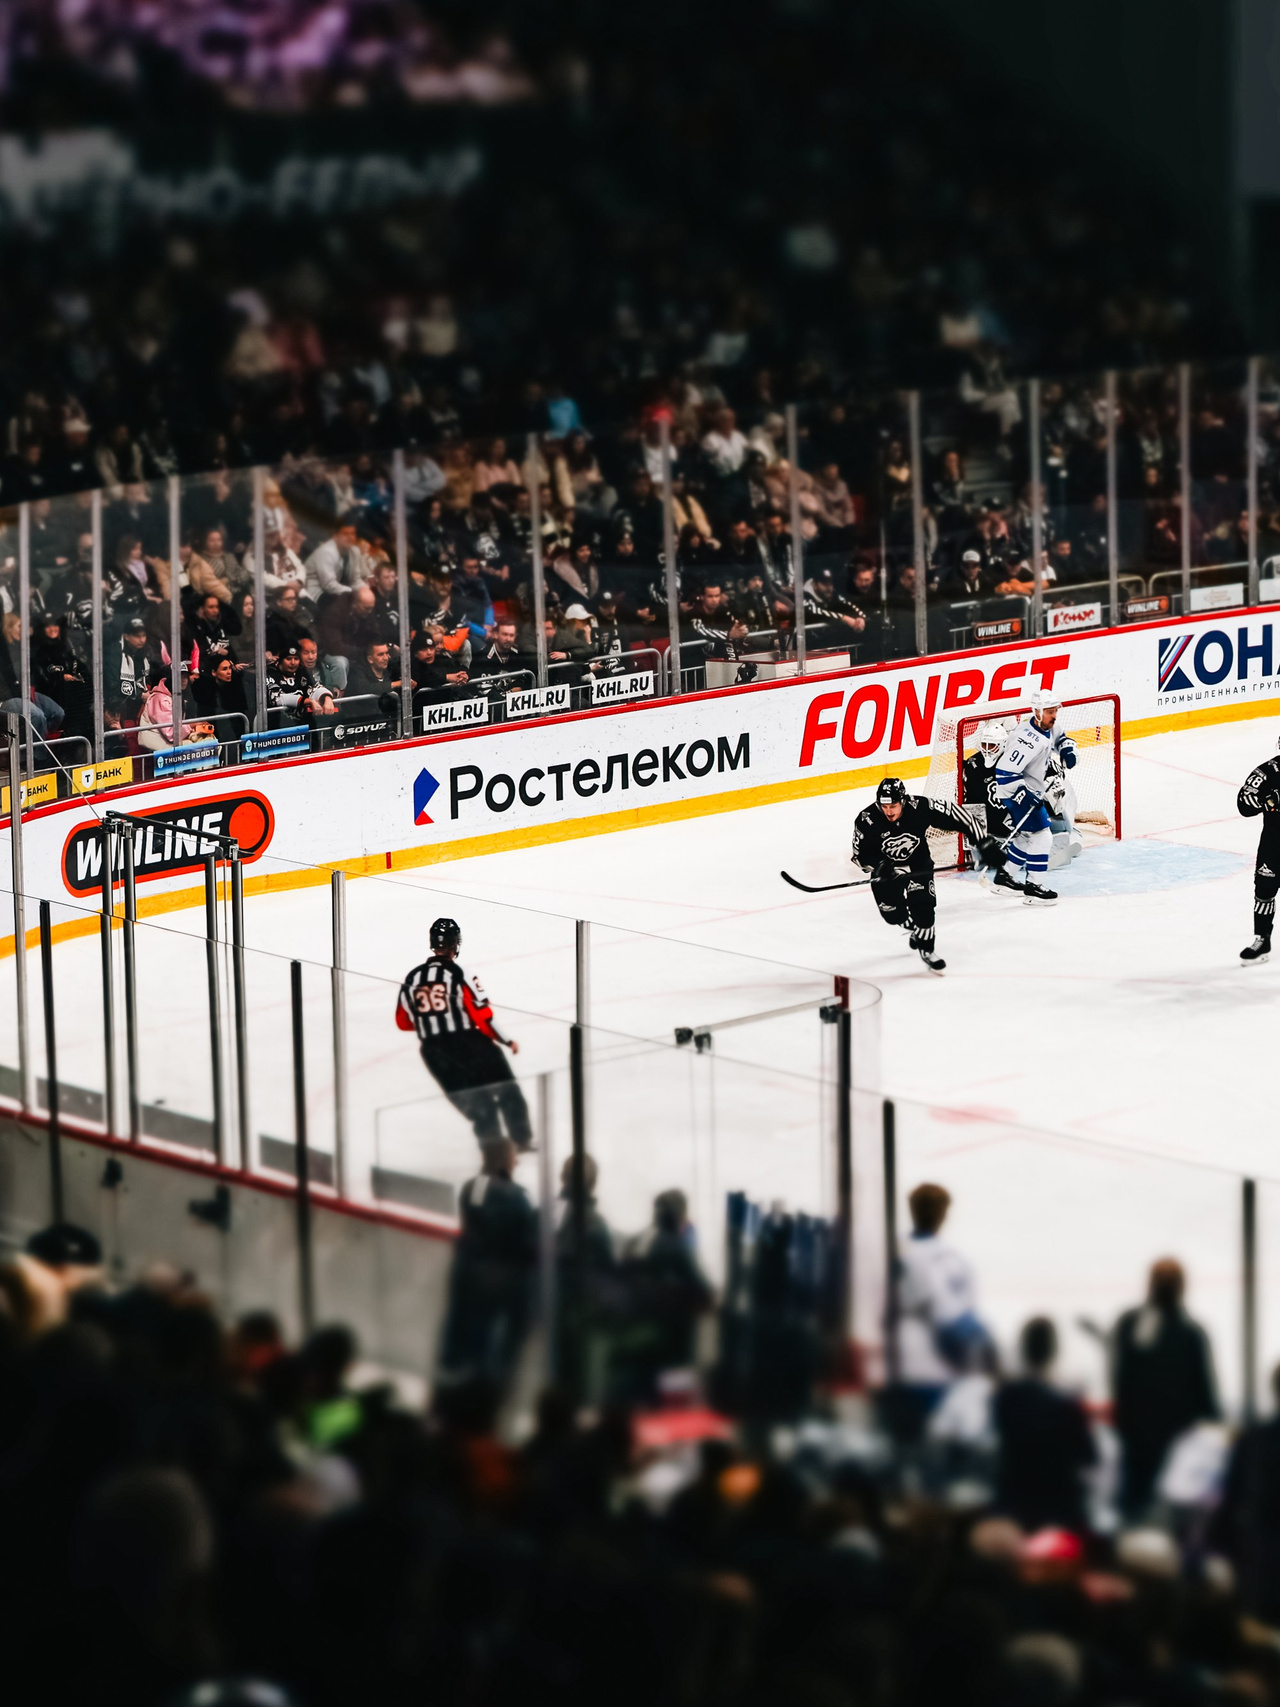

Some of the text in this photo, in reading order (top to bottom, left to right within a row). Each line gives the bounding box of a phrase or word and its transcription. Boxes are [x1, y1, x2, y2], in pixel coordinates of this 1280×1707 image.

[977, 622, 1012, 637] WINLINE
[595, 676, 650, 699] KHL.RU
[1157, 685, 1247, 707] ПРОМЫШЛЕННАЯ
[509, 689, 567, 712] KHL.RU
[427, 702, 485, 726] KHL.RU
[345, 721, 388, 735] SOYUZ
[252, 733, 307, 749] THUNDEROBOT
[163, 748, 216, 764] THUNDEROBOT
[1008, 749, 1026, 767] 91
[95, 767, 122, 781] БАНК
[449, 732, 751, 820] Ростелеком
[1246, 774, 1264, 789] 48
[27, 783, 49, 797] БАНК
[415, 984, 447, 1013] 36
